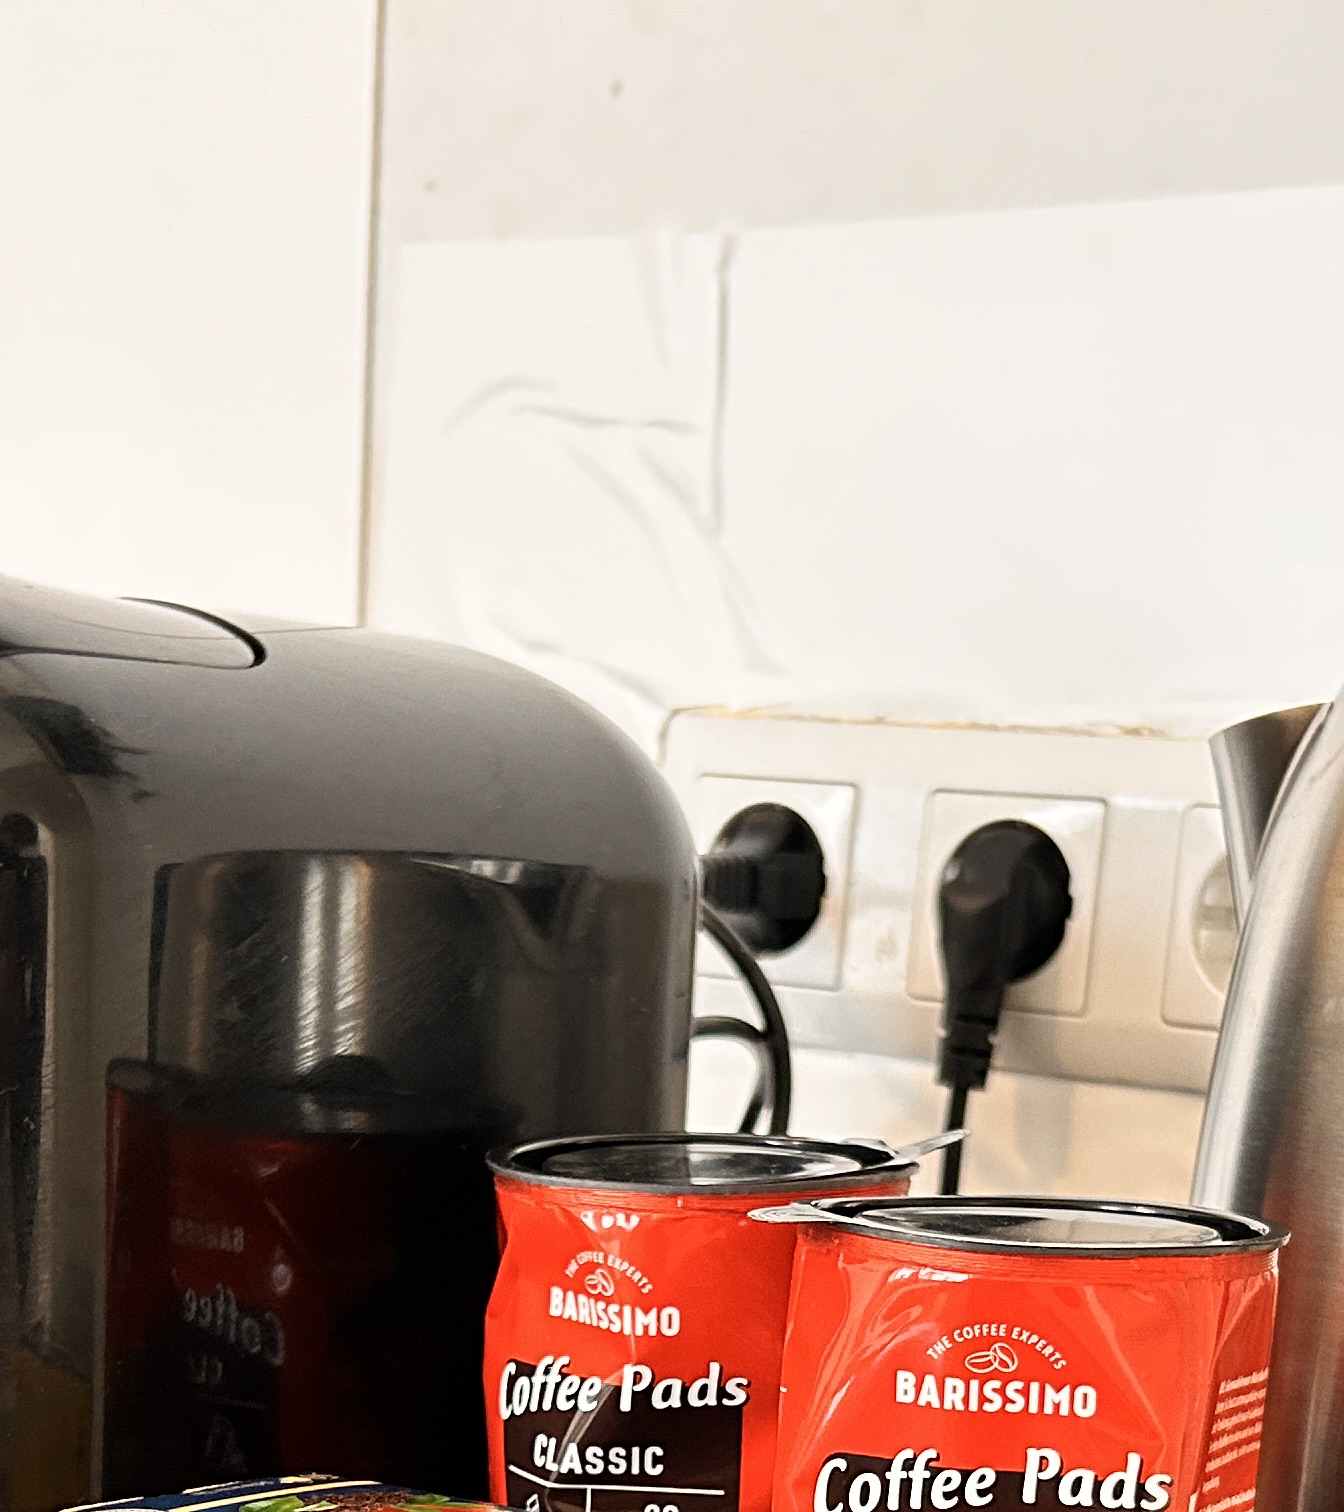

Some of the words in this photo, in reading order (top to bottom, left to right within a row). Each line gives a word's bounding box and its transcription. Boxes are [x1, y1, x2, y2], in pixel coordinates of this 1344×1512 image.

[607, 1254, 653, 1294] EXPERTS
[549, 1285, 680, 1337] BARISSIMO
[926, 1335, 953, 1360] THE
[953, 1323, 1007, 1343] COFFEE
[1011, 1327, 1067, 1370] EXPERTS
[499, 1356, 601, 1419] Coffee
[619, 1362, 751, 1412] Pads
[895, 1369, 1097, 1418] BARISSIMO
[534, 1434, 664, 1476] CLASSIC
[1022, 1447, 1173, 1511] Pads
